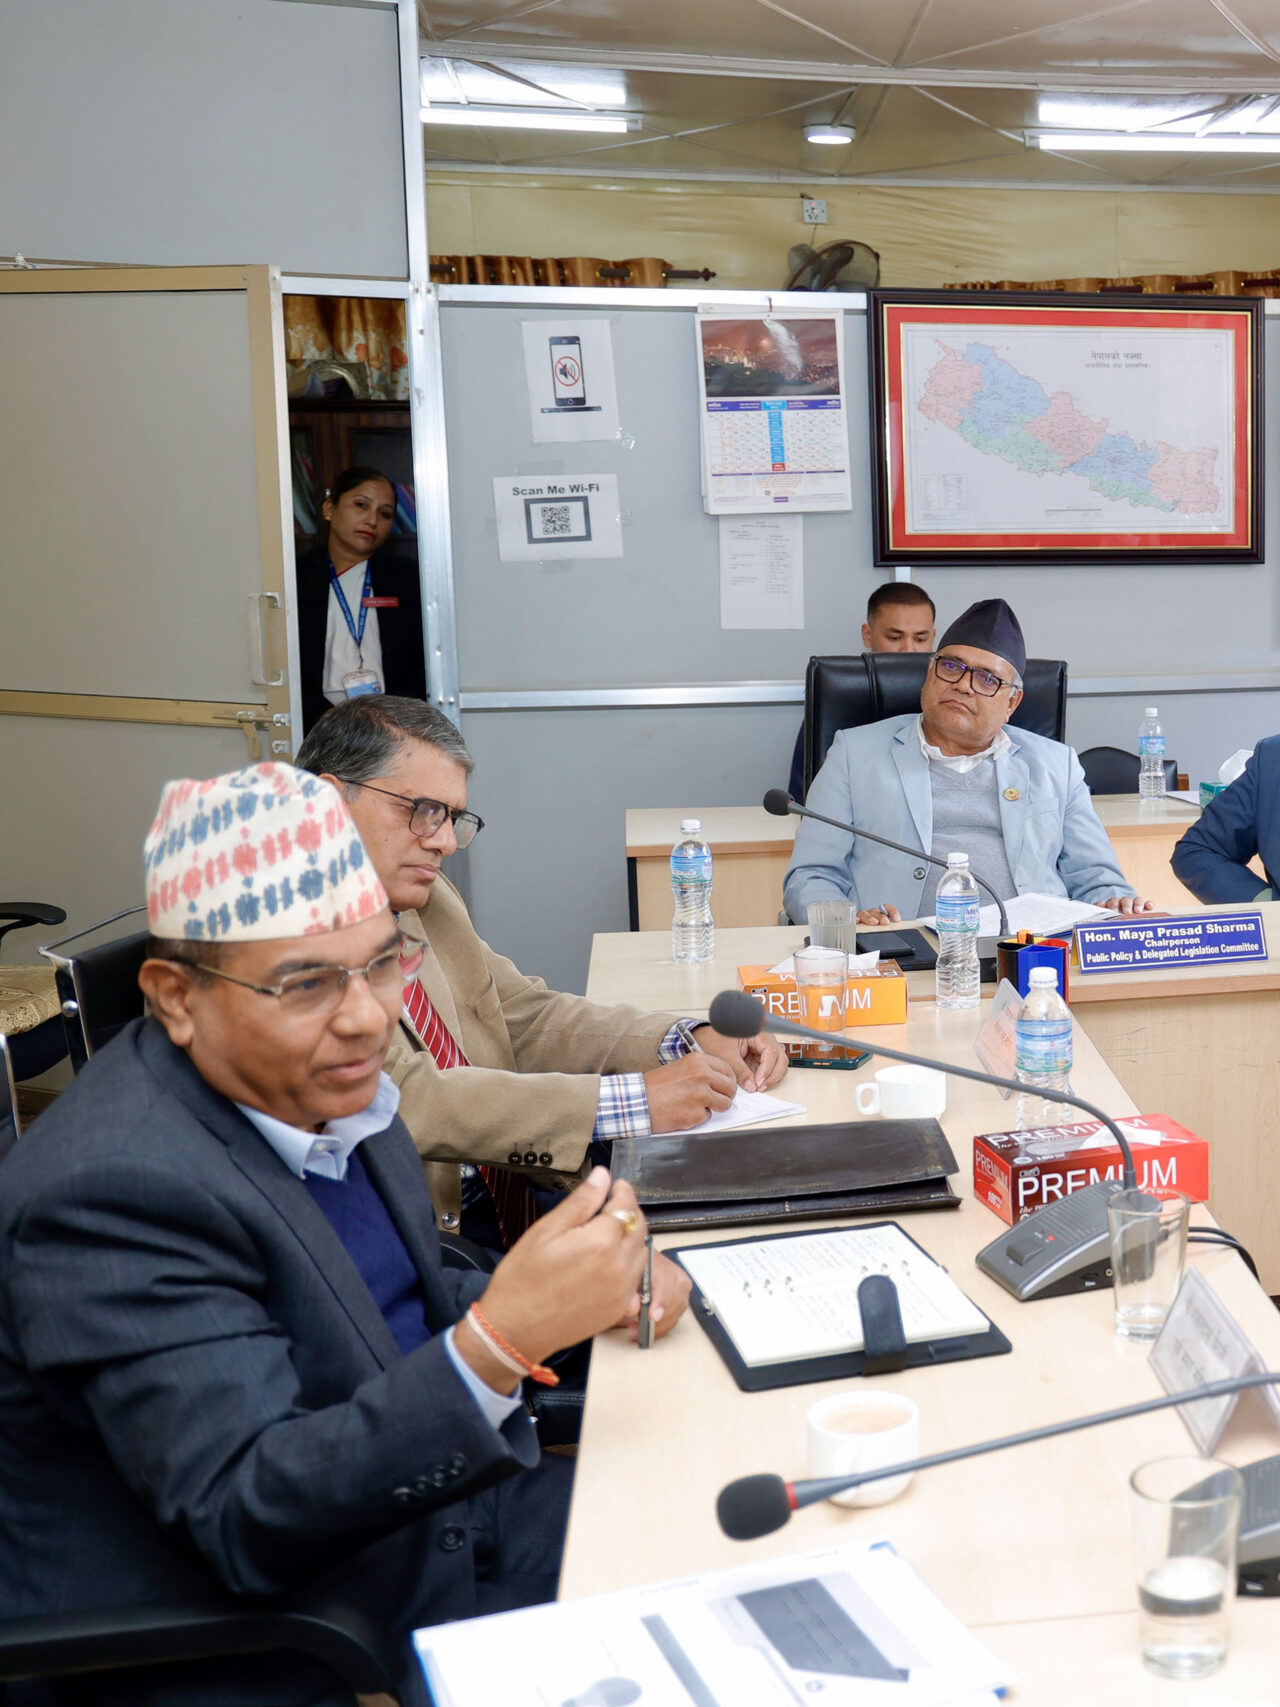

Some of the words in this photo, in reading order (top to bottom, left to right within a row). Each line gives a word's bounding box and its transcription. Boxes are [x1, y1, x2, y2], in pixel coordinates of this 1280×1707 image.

[512, 487, 543, 496] Scan
[547, 485, 565, 494] Me
[569, 483, 600, 493] Wi-Fi
[1085, 932, 1116, 943] Hon.
[1119, 929, 1154, 942] Maya
[1157, 925, 1203, 938] Prasad
[1206, 922, 1256, 934] Sharma
[1144, 937, 1201, 949] Chairperson
[1086, 953, 1110, 964] Public
[1111, 951, 1133, 963] Policy
[1135, 951, 1142, 960] &
[1142, 947, 1179, 961] Delegated
[1180, 944, 1220, 958] Legislation
[1220, 943, 1260, 953] Committee
